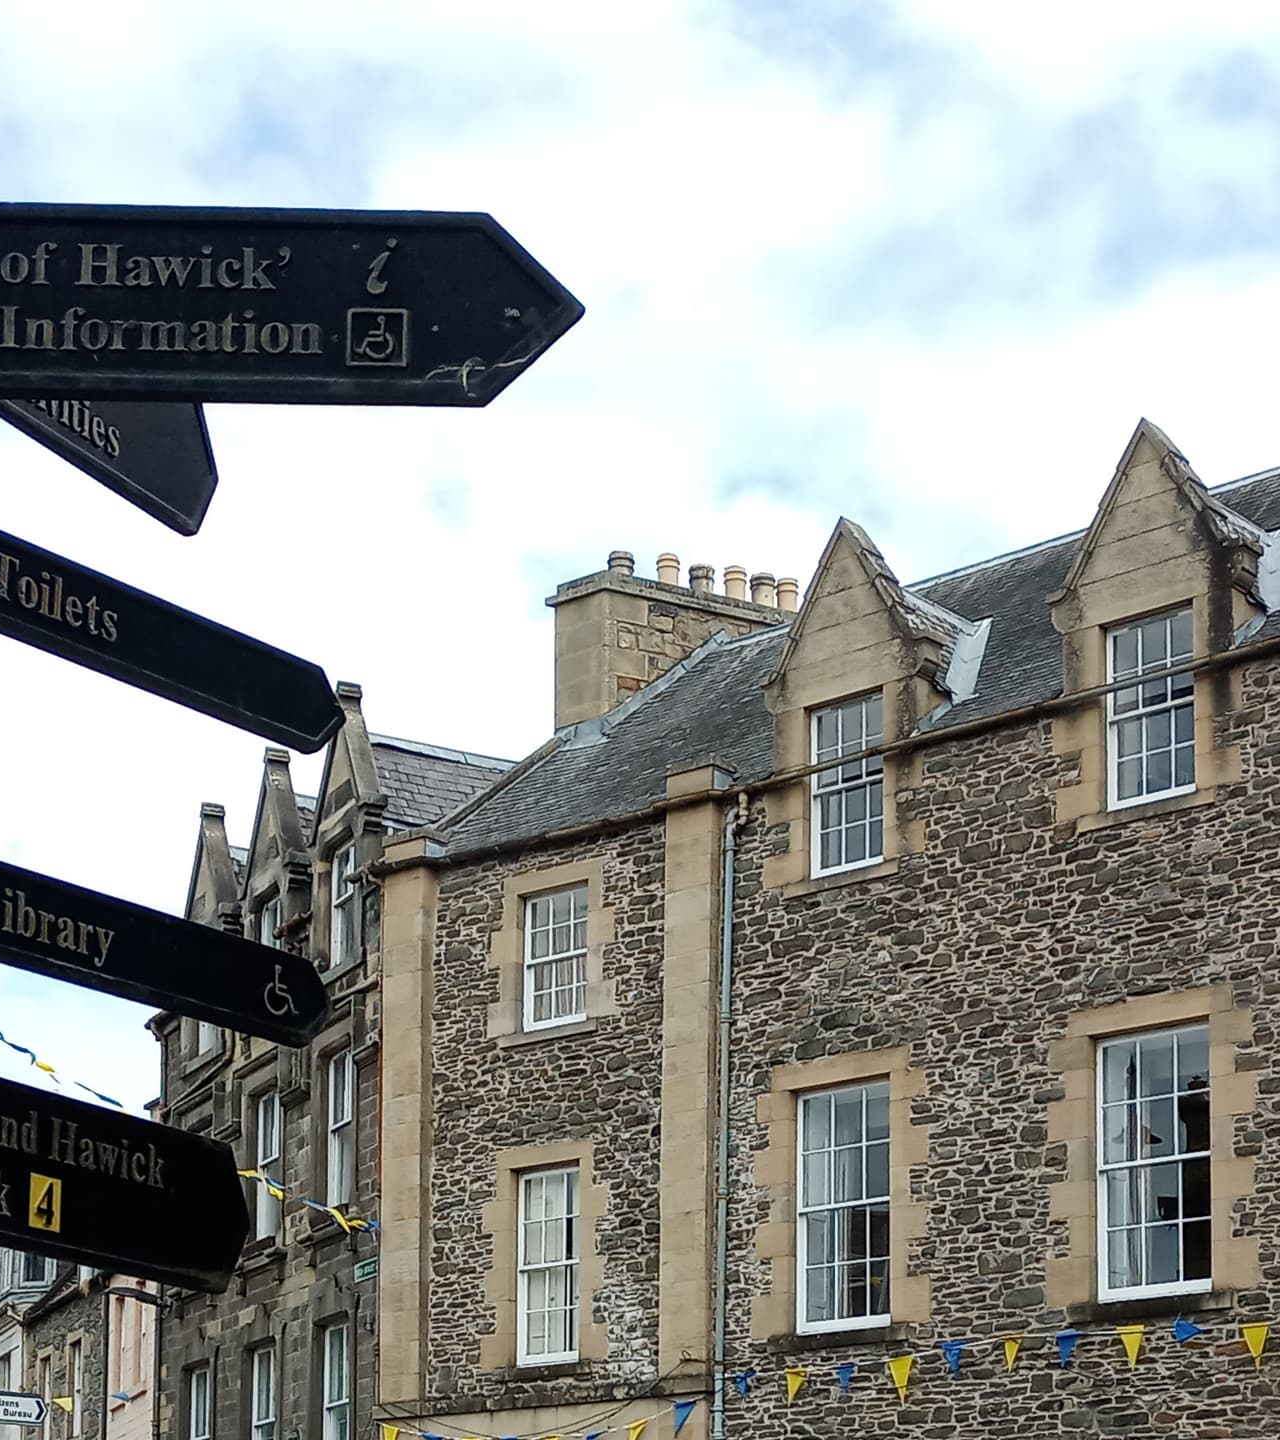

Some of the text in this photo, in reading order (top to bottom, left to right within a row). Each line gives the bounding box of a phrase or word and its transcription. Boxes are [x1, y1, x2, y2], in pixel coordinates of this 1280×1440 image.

[0, 241, 58, 286] of
[49, 1117, 166, 1189] Hawick
[35, 1181, 57, 1228] 4
[3, 1408, 32, 1418] Bureau
